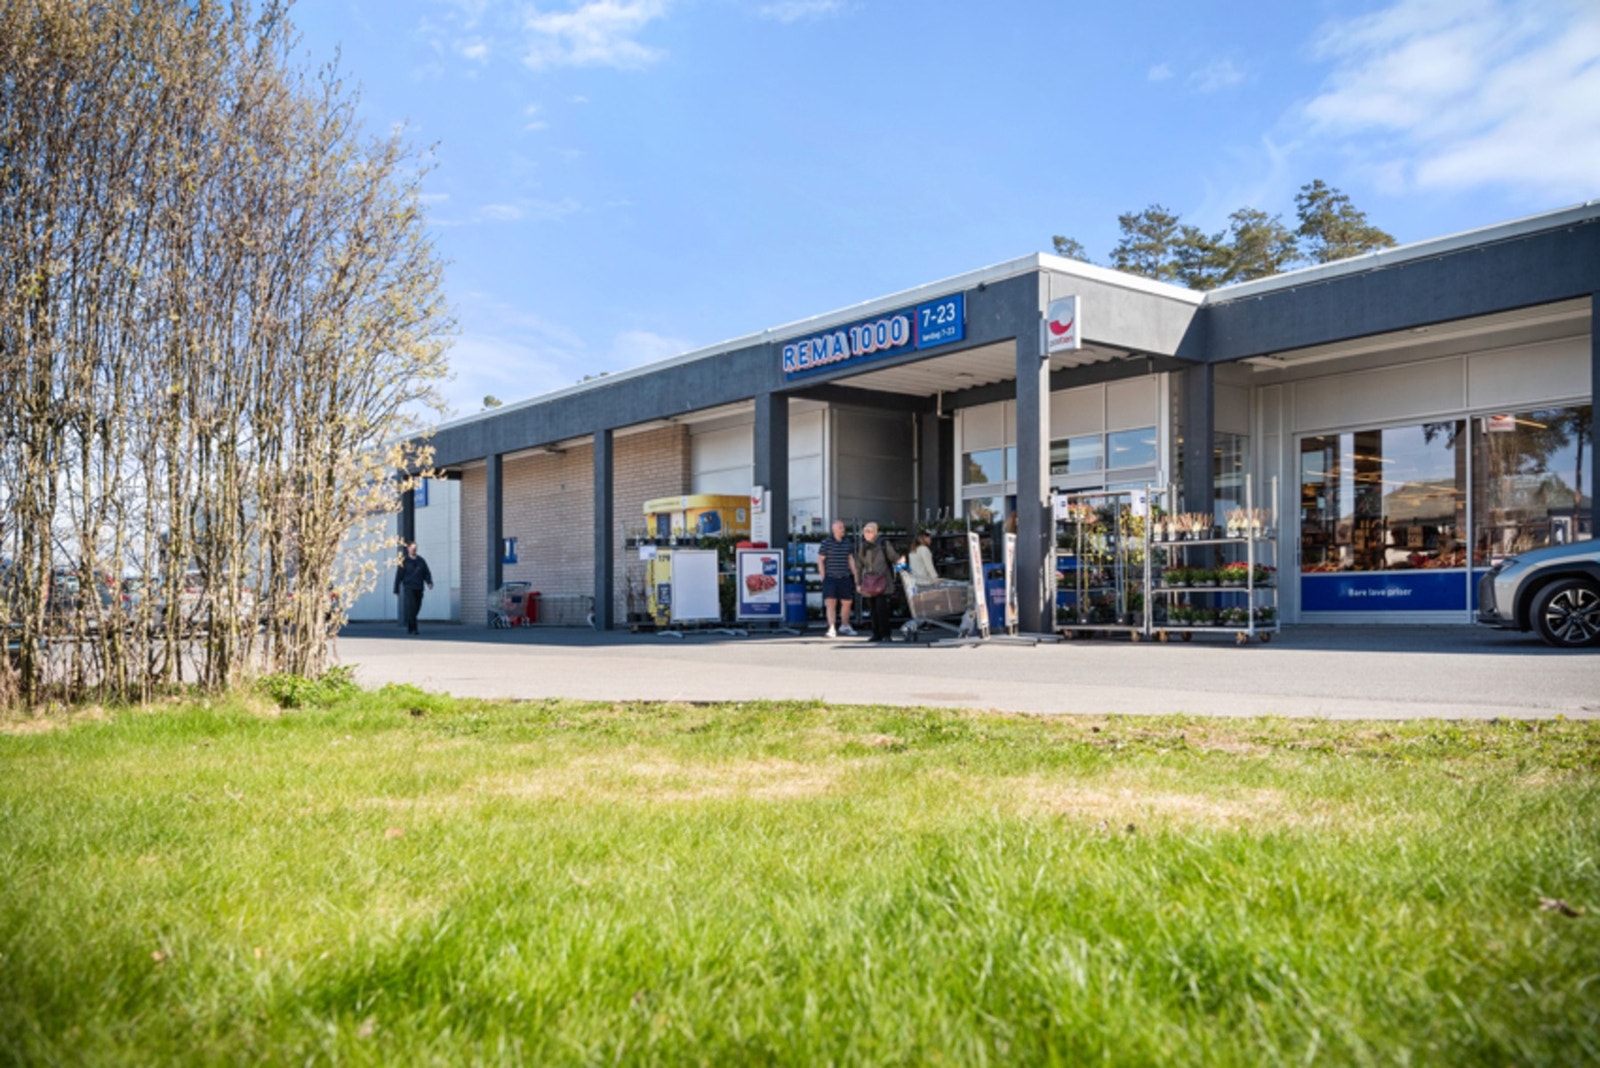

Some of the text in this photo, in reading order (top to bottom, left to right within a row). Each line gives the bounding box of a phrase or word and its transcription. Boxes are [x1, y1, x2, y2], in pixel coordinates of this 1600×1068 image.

[922, 302, 955, 328] 7-23
[783, 316, 909, 372] REMA 1000
[1348, 588, 1367, 596] Bare
[1387, 587, 1412, 597] priser
